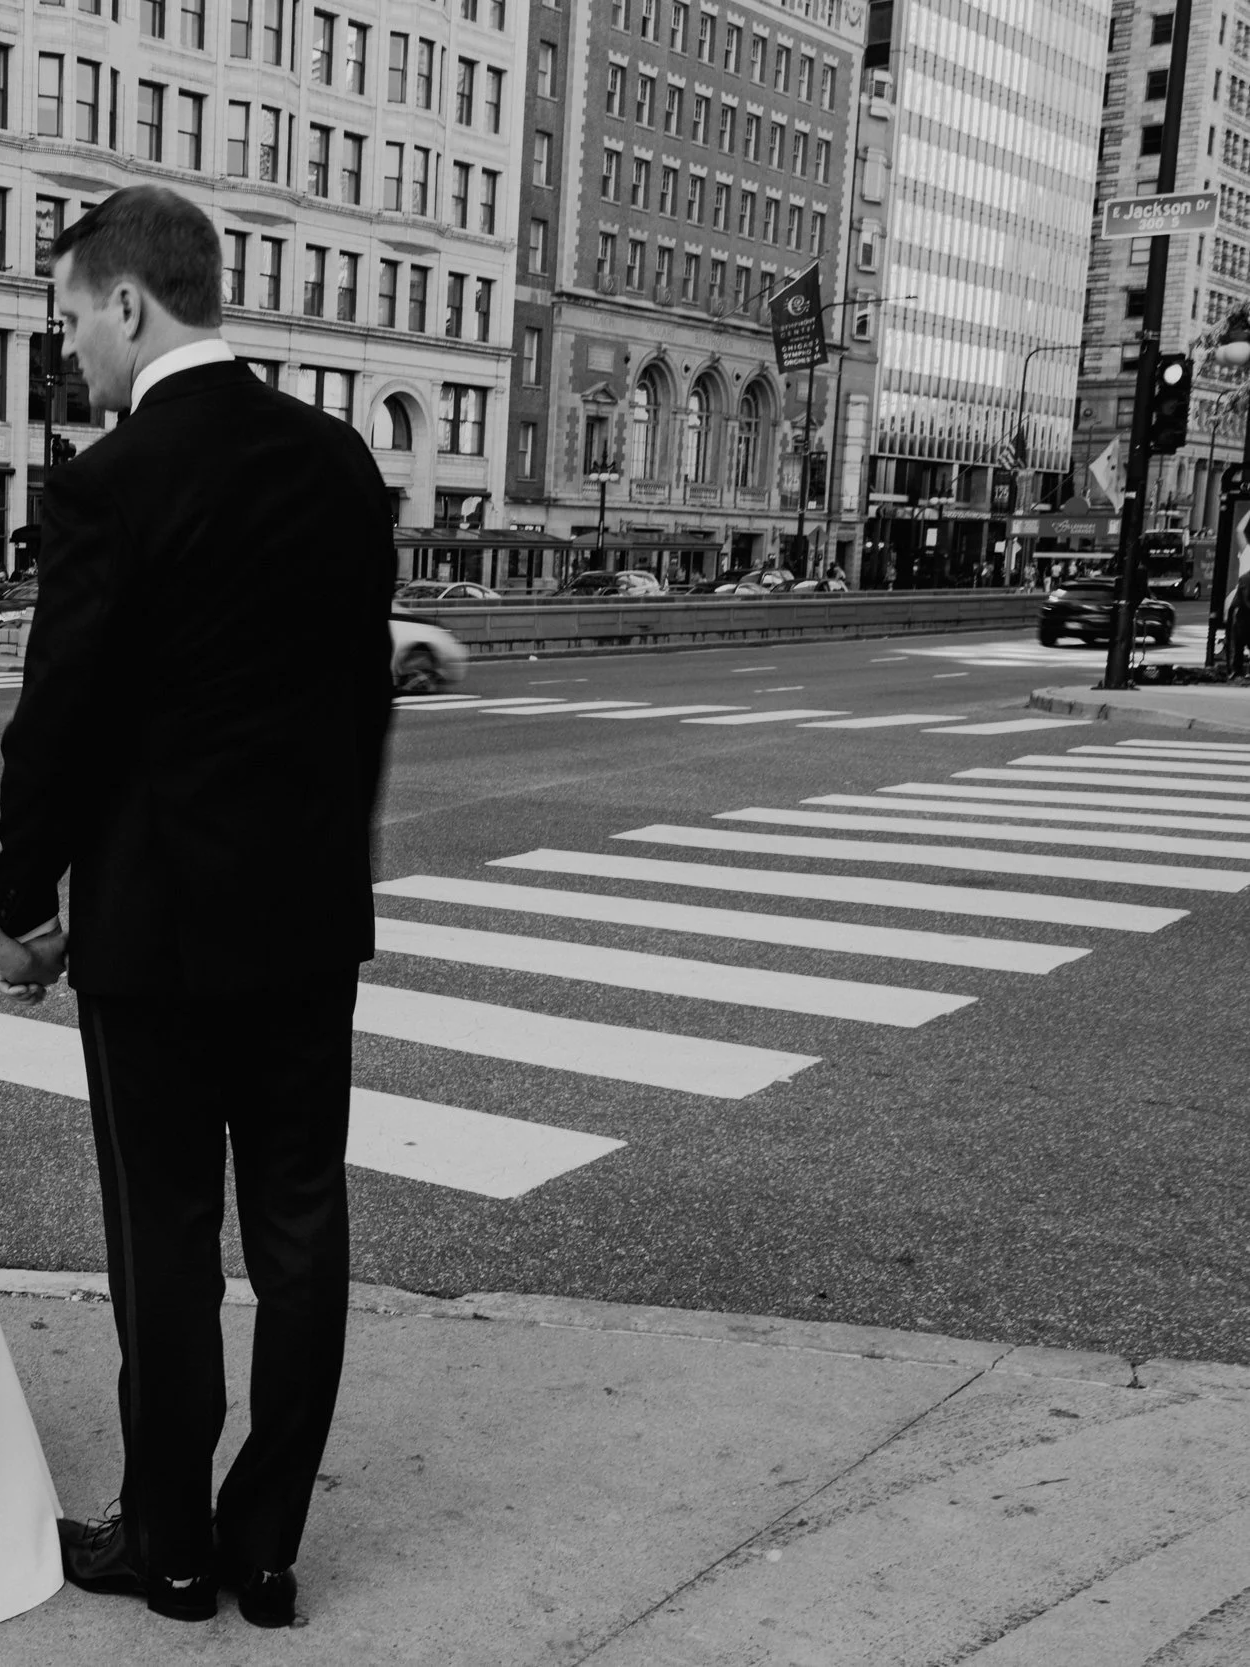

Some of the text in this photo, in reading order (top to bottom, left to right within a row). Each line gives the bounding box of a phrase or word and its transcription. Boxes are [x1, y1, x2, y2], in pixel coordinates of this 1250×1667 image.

[1112, 199, 1211, 220] E Jackson Dr
[1138, 216, 1181, 231] 300 S
[782, 345, 820, 361] SYMPHOY
[783, 352, 822, 367] ORCHESRA
